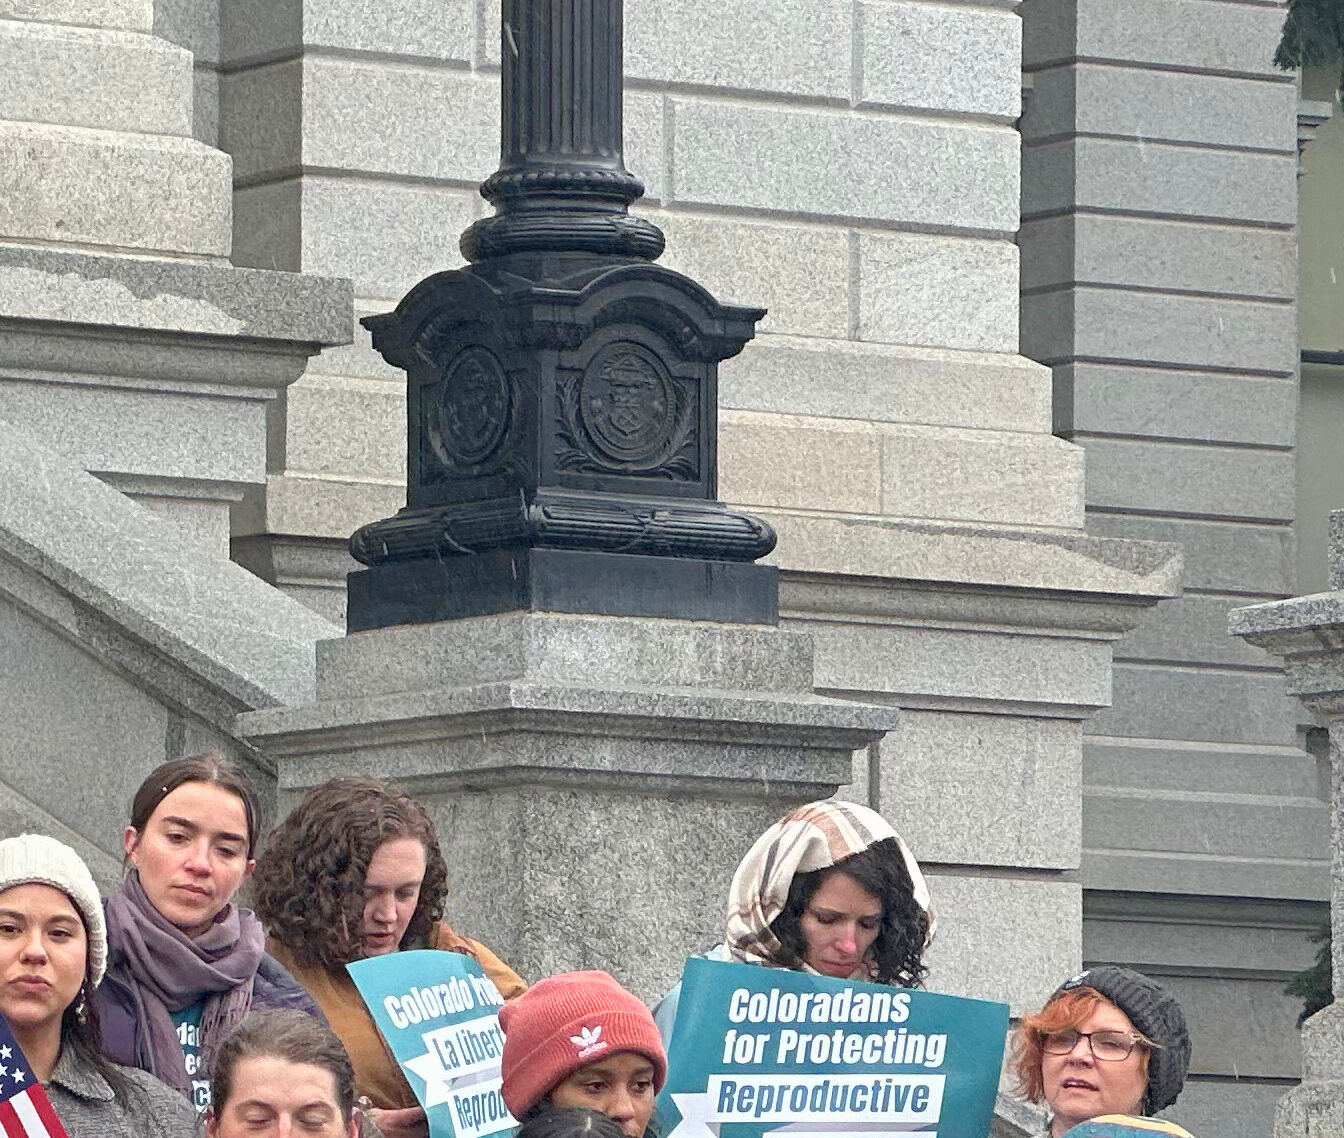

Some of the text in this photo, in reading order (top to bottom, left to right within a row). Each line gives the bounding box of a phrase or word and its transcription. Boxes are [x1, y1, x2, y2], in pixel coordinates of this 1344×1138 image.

[383, 975, 475, 1029] Colorado
[728, 988, 912, 1023] Coloradans
[432, 1036, 460, 1070] La
[722, 1028, 948, 1068] for Protecting
[717, 1079, 930, 1118] Reproductive
